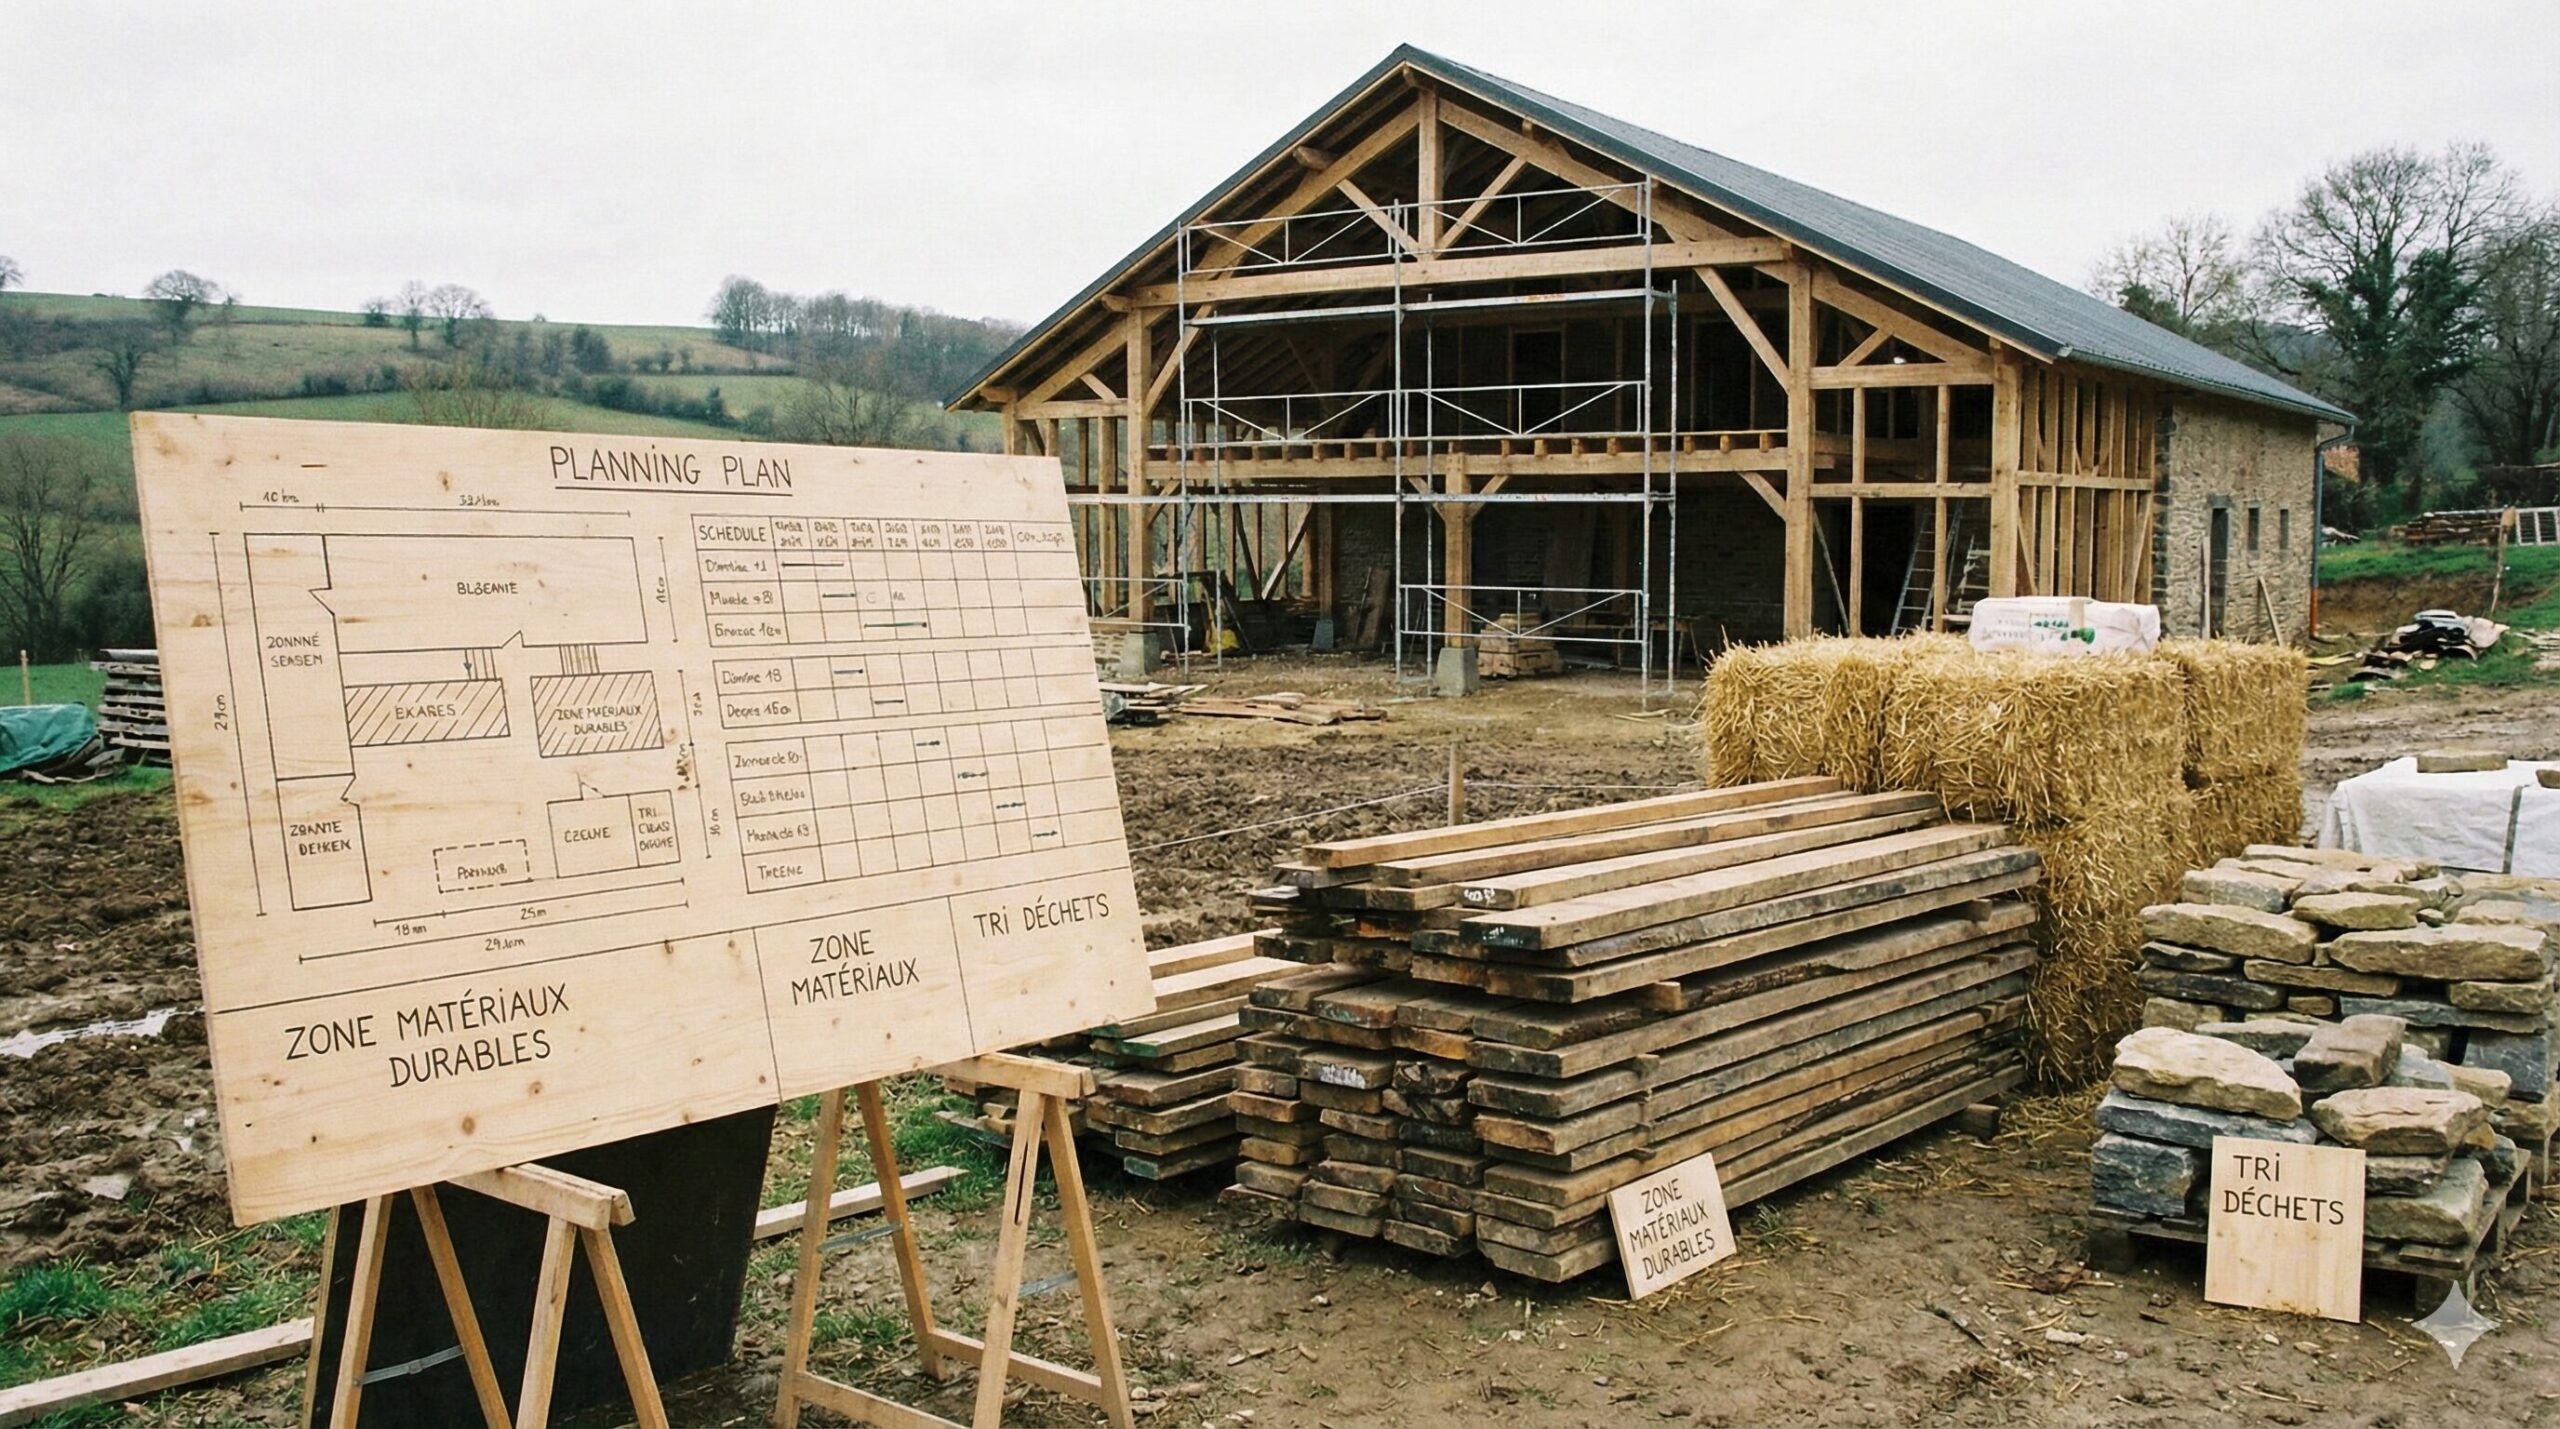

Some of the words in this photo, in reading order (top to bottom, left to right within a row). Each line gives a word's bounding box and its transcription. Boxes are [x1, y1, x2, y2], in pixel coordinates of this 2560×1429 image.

[722, 455, 792, 488] PLAN
[699, 524, 767, 542] SCHEDULE
[1022, 893, 1110, 932] DÉCHETS
[809, 929, 875, 964] ZONE
[285, 1015, 377, 1060] ZONE
[389, 1029, 551, 1088] DURABLES
[1641, 1178, 1683, 1215] ZONE
[2222, 1186, 2344, 1225] DÉCHETS
[1628, 1200, 1709, 1253] MATÉRIAUX
[1642, 1228, 1716, 1281] DURABLES
